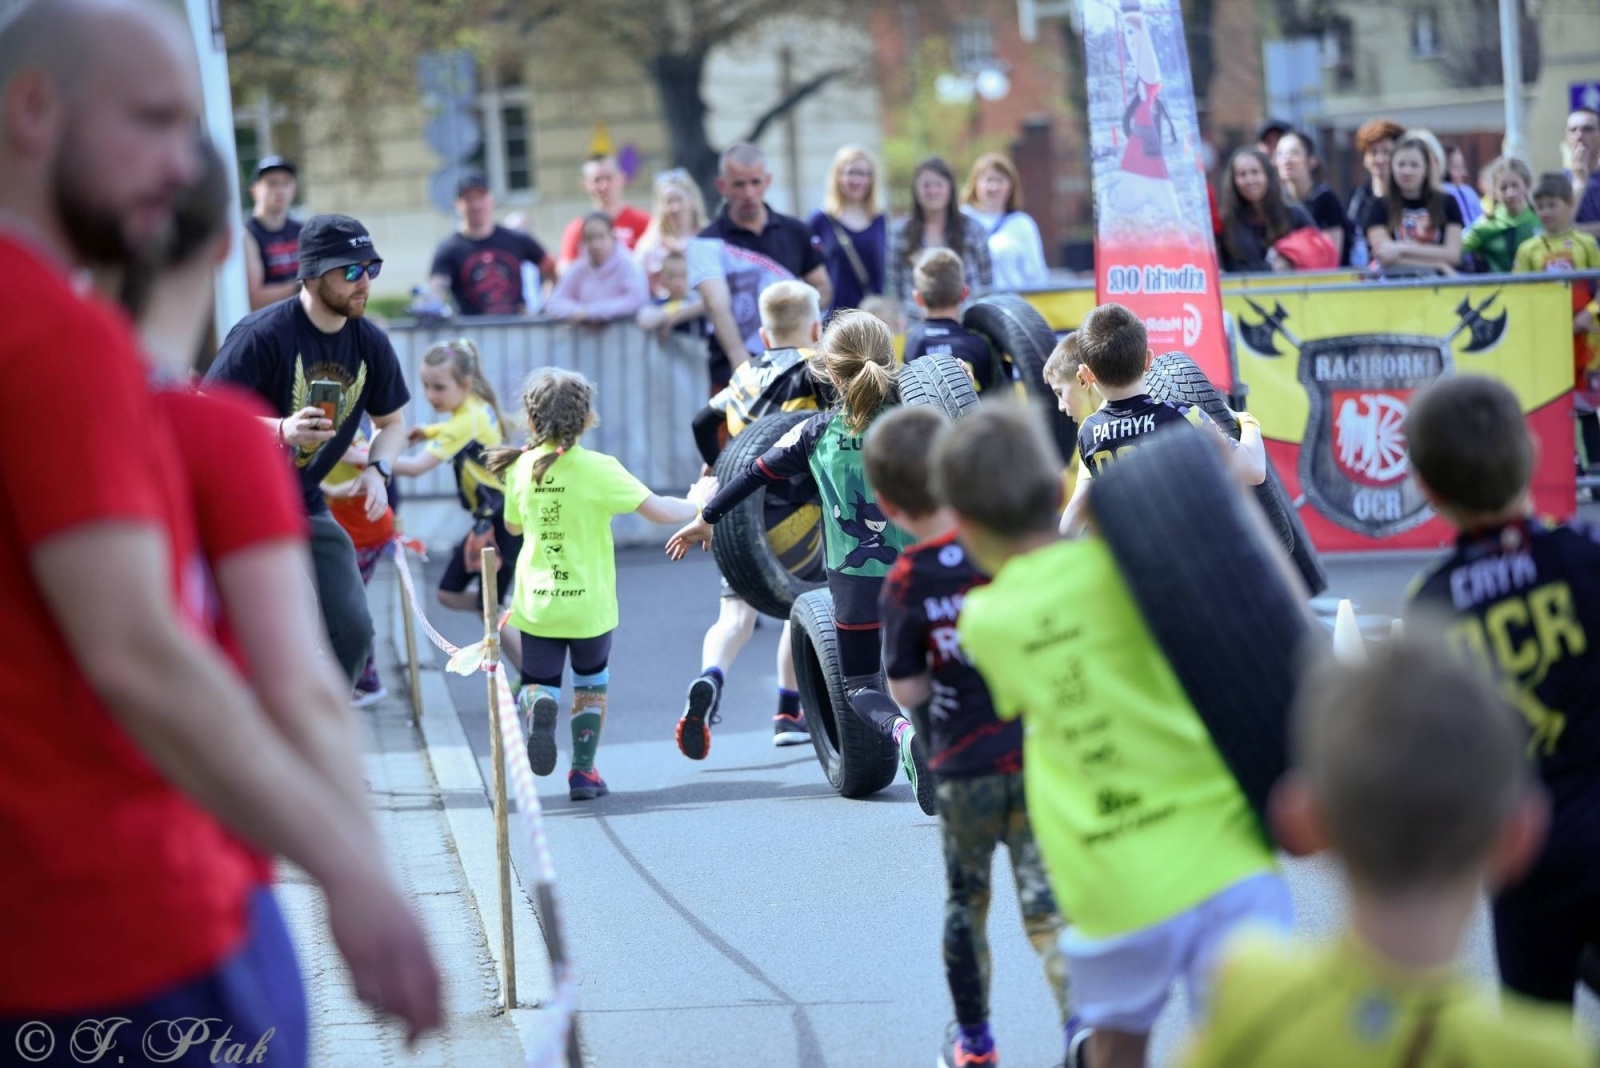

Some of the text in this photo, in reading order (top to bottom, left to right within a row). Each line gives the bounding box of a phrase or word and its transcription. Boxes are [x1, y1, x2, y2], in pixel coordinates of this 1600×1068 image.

[1315, 353, 1435, 381] RACIBORKI
[1093, 413, 1155, 444] PATRYK
[1353, 489, 1401, 520] OCR
